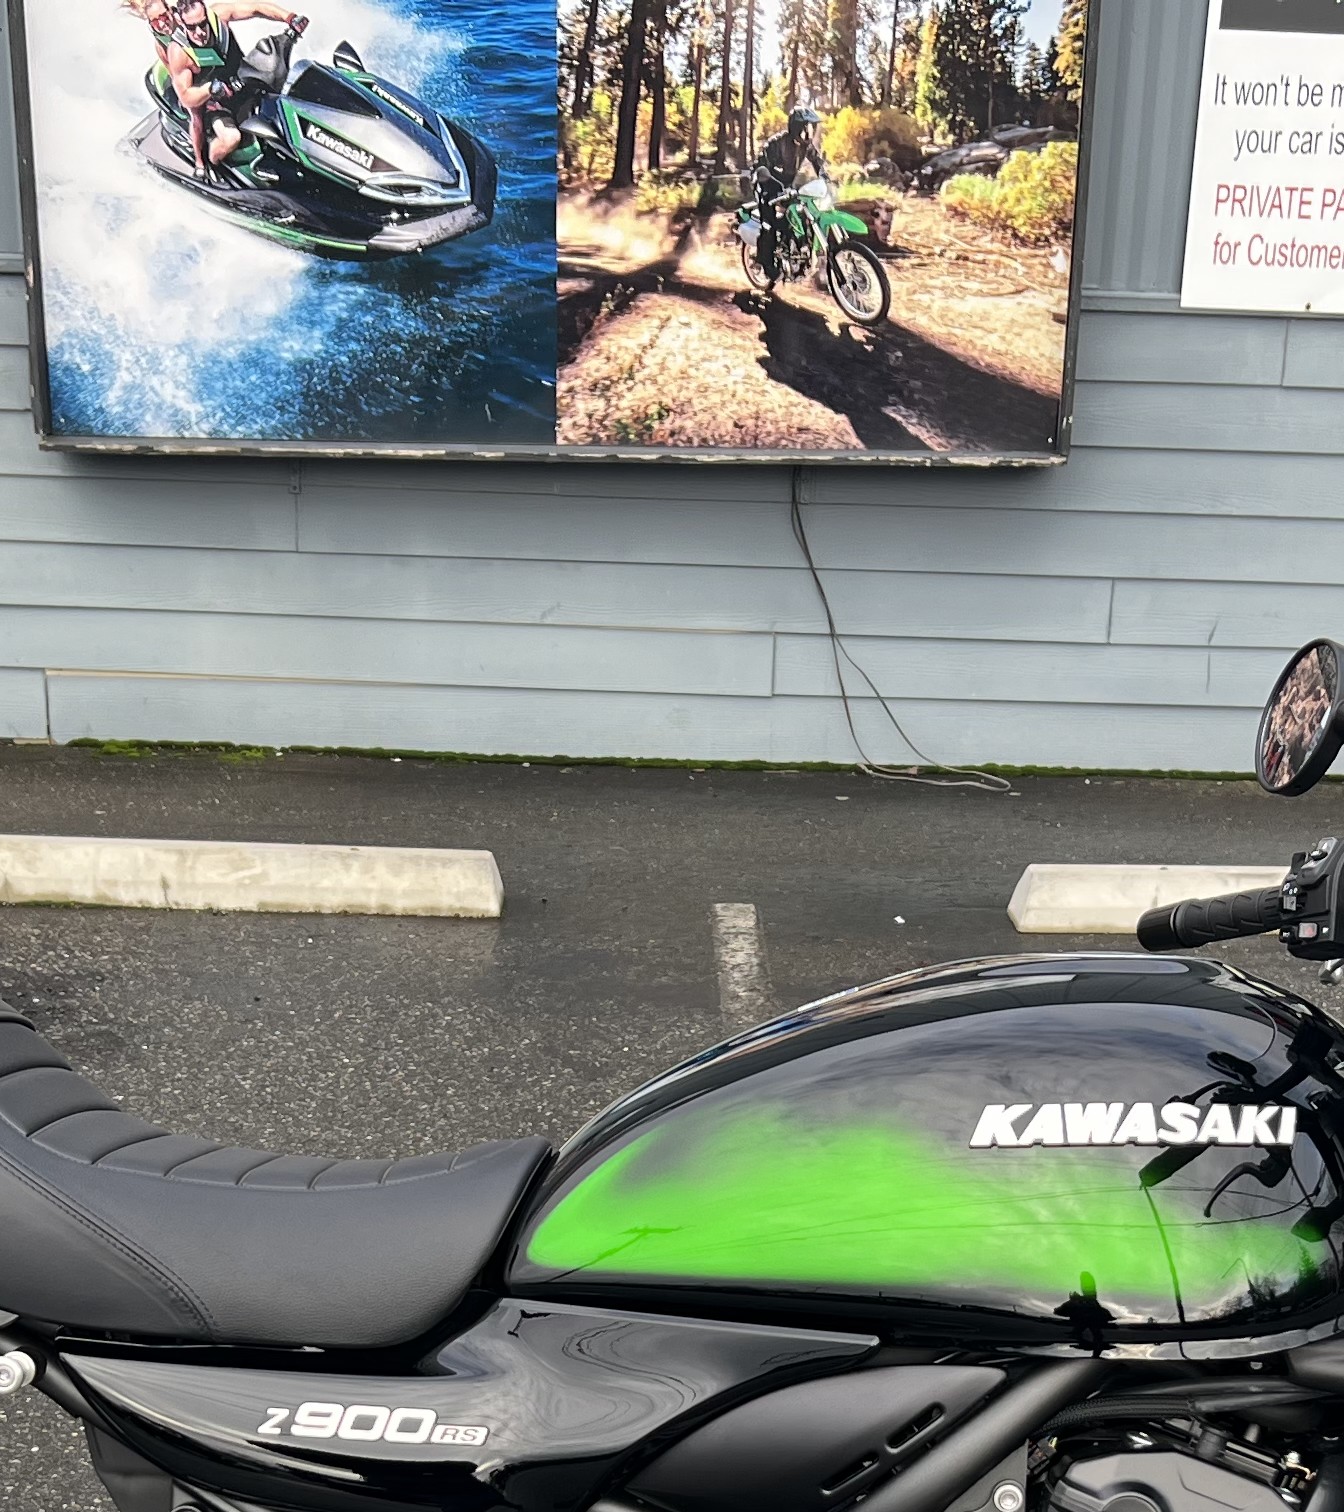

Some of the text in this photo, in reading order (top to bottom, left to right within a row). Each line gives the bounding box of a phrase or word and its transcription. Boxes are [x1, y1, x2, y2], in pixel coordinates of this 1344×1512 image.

[1214, 72, 1228, 106] It
[1234, 74, 1291, 107] won't
[1297, 75, 1323, 108] be
[306, 124, 375, 169] Kawasaki
[1233, 127, 1282, 161] your
[1288, 131, 1323, 156] car
[1214, 184, 1315, 220] PRIVATE
[1212, 232, 1242, 266] for
[969, 1102, 1298, 1149] KAWASAKI
